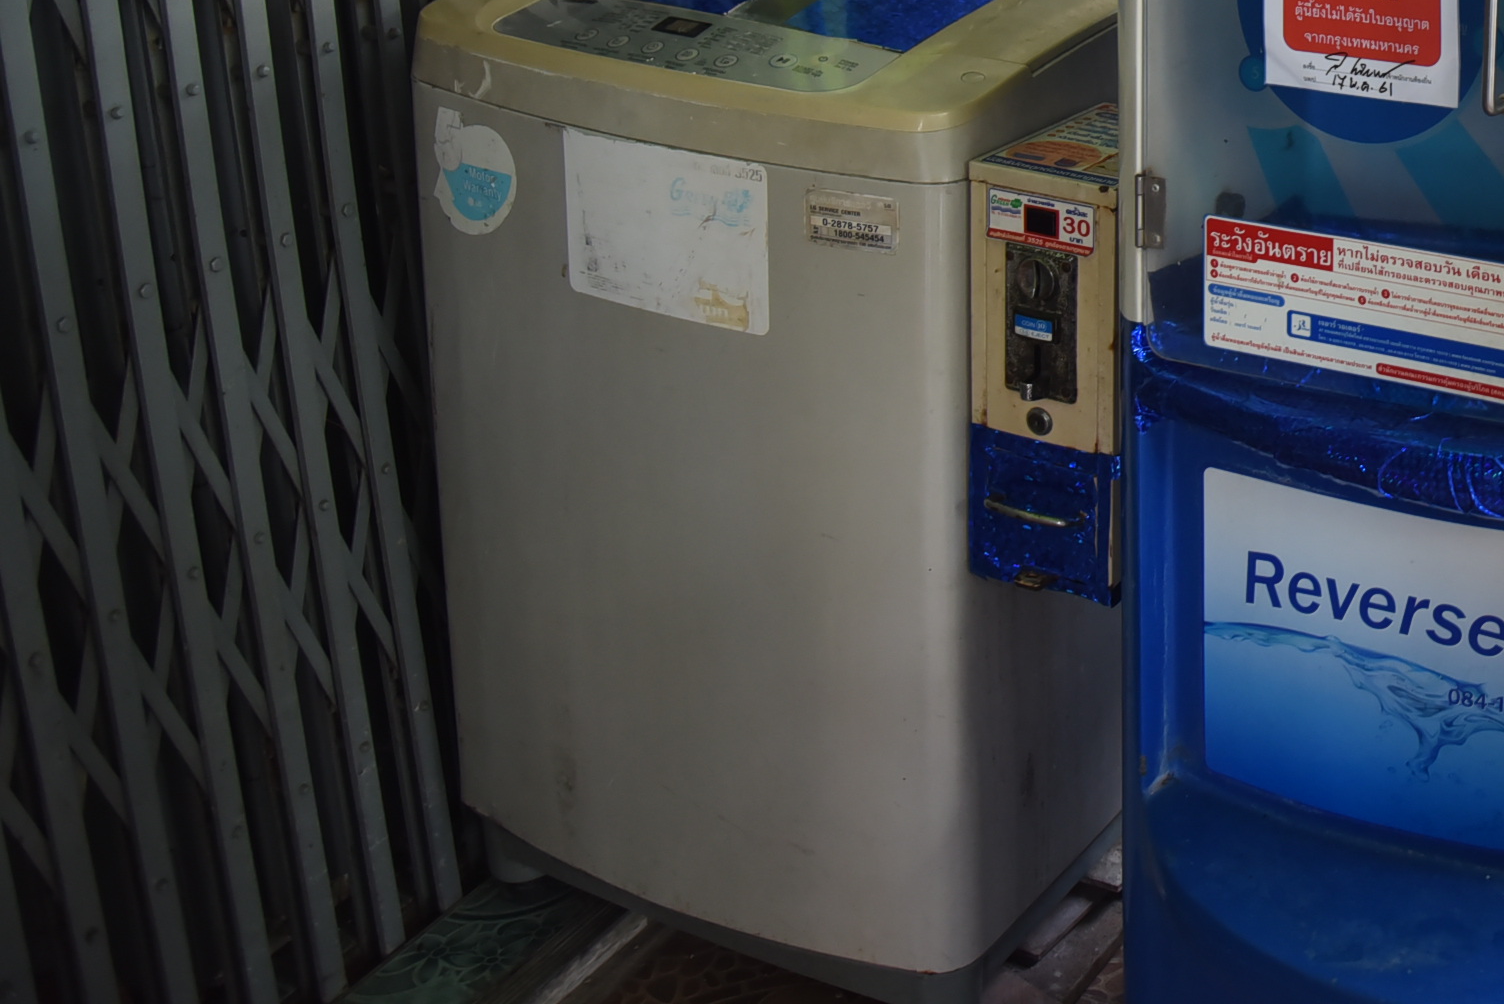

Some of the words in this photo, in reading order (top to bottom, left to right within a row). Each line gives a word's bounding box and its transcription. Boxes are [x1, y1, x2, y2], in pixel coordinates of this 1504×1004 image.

[1295, 0, 1430, 32] ตู้นี้ยังไม่ได้รับใบอนุญาต
[1304, 31, 1420, 56] จากกรุงเทพมหานคร
[1378, 81, 1393, 97] 61
[822, 218, 879, 233] 0-2878-5757
[1062, 216, 1091, 238] 30
[834, 229, 885, 243] 1800-545454
[1027, 236, 1044, 246] 3525
[1069, 236, 1084, 245] บาท
[1210, 227, 1332, 266] ระวังอันตราย
[1337, 245, 1462, 277] หากไม่ตรวจสอบวัน
[1466, 265, 1501, 283] เดือน
